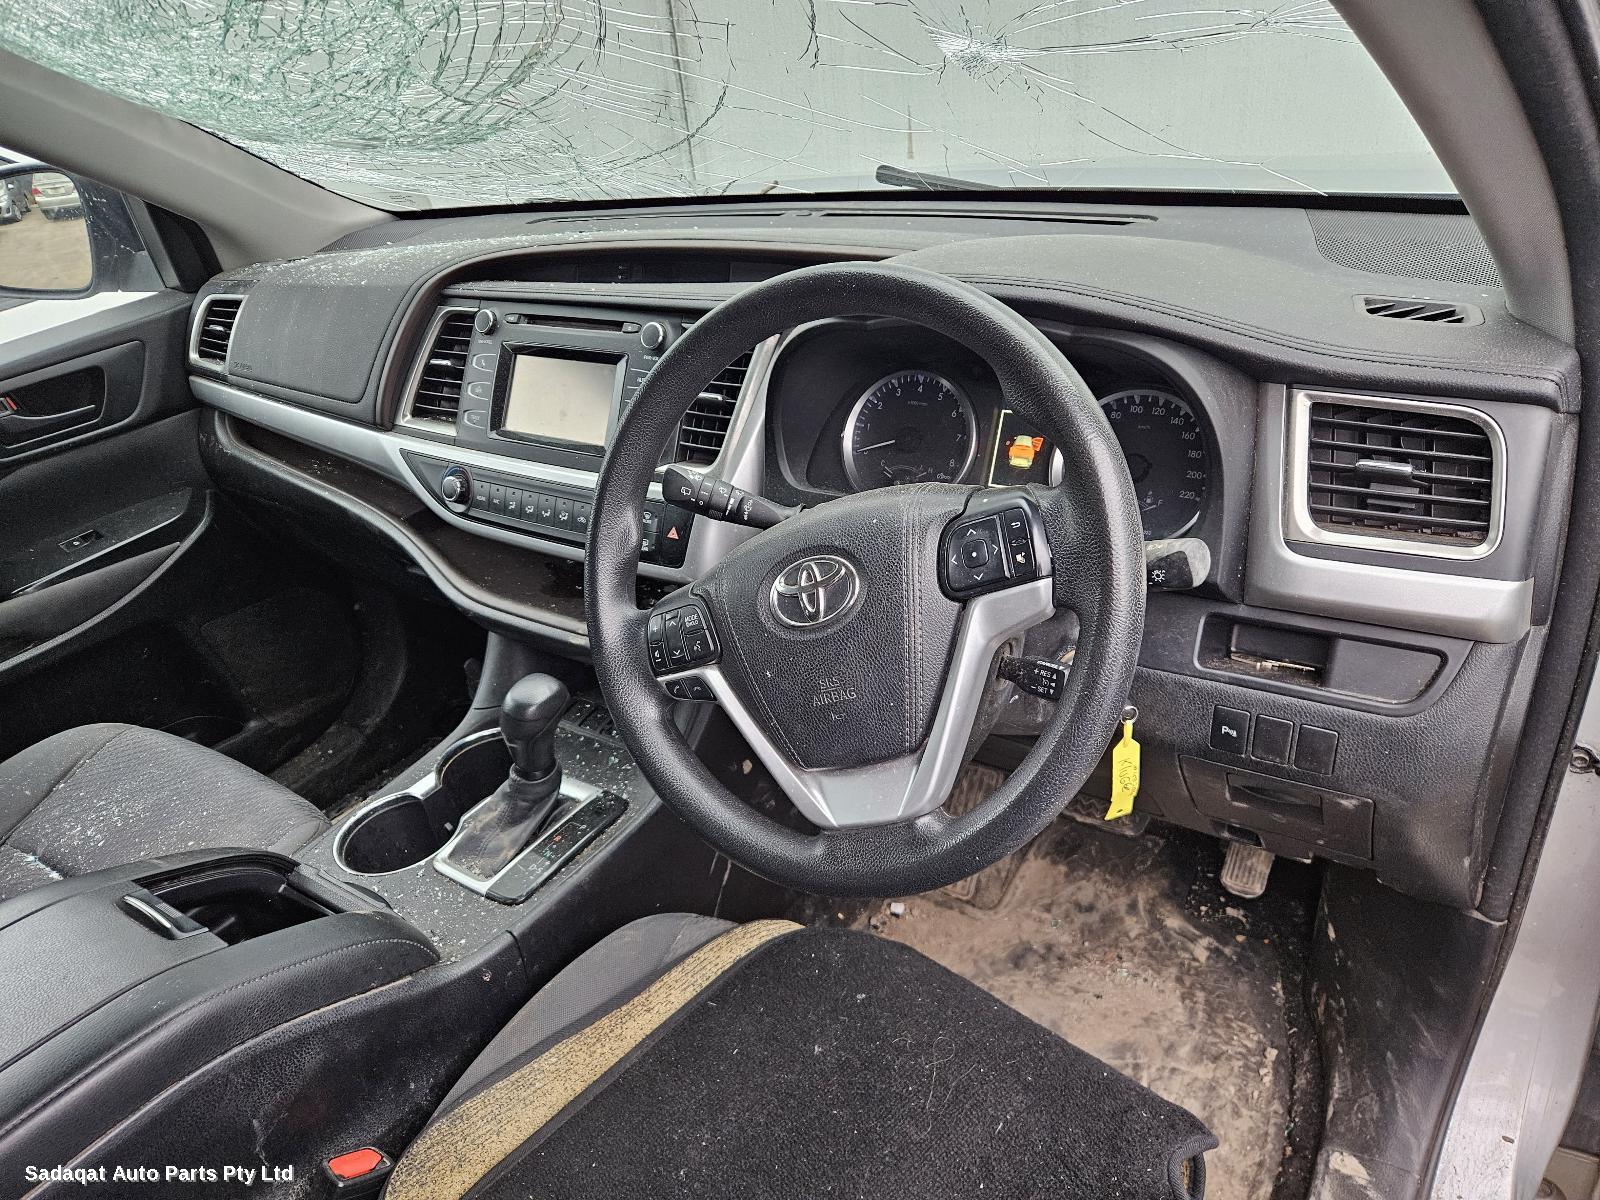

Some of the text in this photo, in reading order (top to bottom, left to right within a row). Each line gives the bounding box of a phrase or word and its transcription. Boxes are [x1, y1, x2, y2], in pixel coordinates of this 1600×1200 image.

[895, 388, 901, 397] 3
[917, 384, 923, 393] 4
[937, 392, 943, 401] 5
[877, 401, 883, 410] 2
[1130, 405, 1143, 414] 100
[951, 409, 957, 418] 6
[1110, 411, 1121, 419] 80
[1152, 407, 1165, 416] 120
[1170, 416, 1184, 426] 140
[956, 433, 962, 442] 7
[1181, 431, 1195, 440] 160
[1187, 450, 1202, 459] 180
[949, 458, 955, 467] 8
[1185, 470, 1202, 479] 200
[1179, 490, 1195, 499] 220
[1039, 669, 1051, 678] RES
[819, 677, 840, 688] SRS
[1037, 685, 1048, 694] SET
[813, 687, 857, 707] AIRBAG
